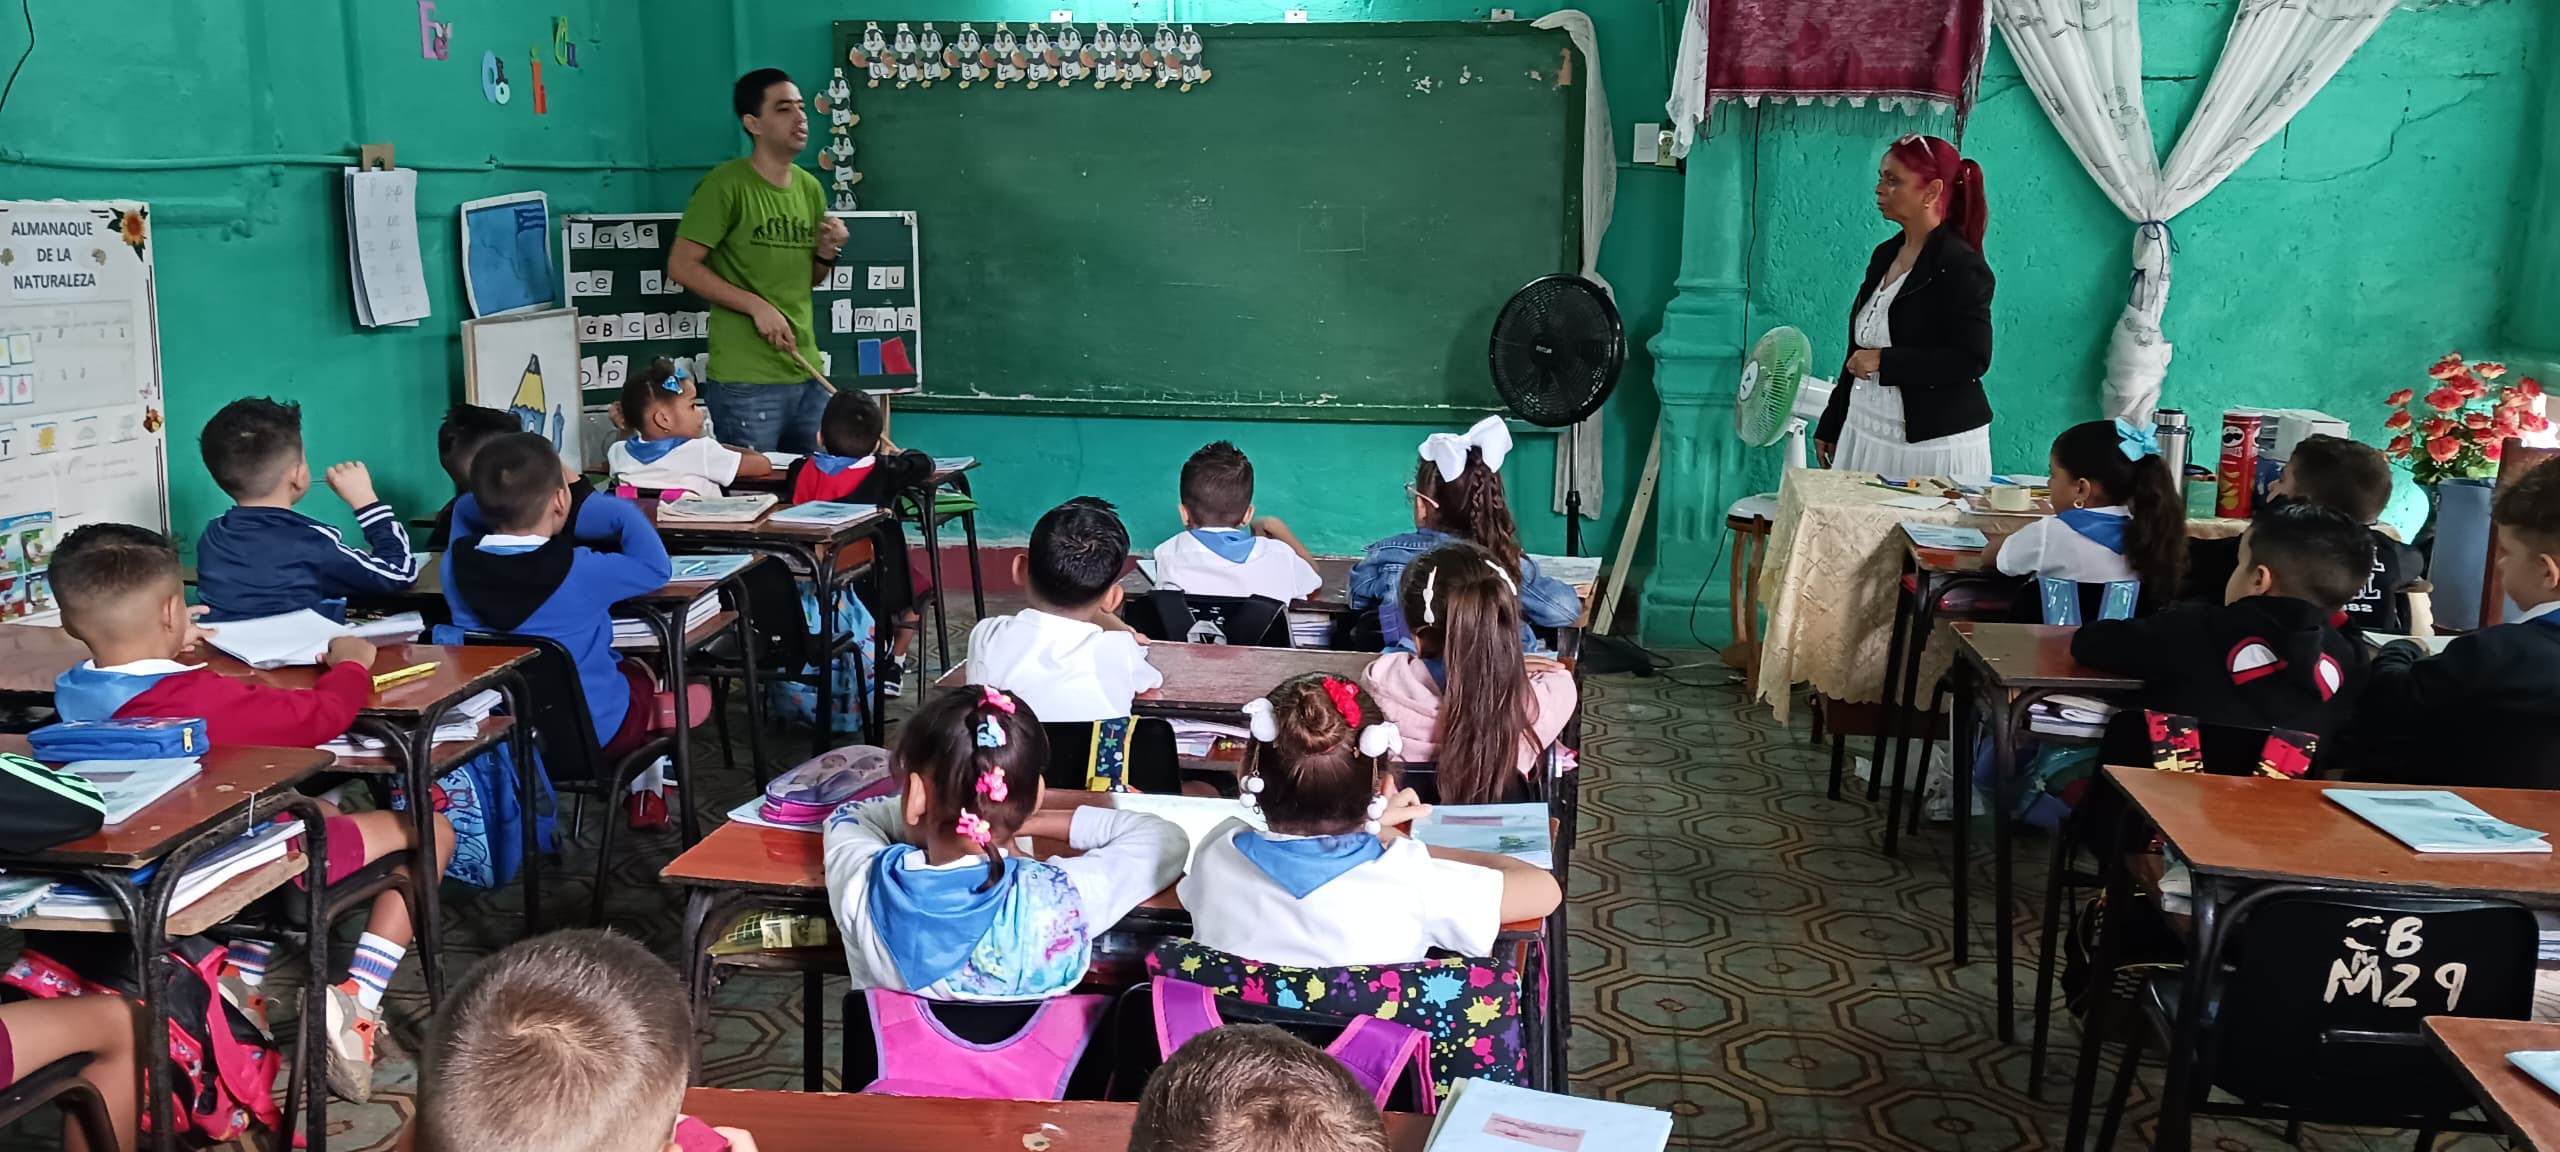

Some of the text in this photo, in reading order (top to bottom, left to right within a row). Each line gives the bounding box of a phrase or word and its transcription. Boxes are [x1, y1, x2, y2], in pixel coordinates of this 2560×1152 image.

[11, 222, 93, 237] ALMANAQUE
[37, 248, 72, 262] DE LA
[14, 273, 96, 290] NATURALEZA
